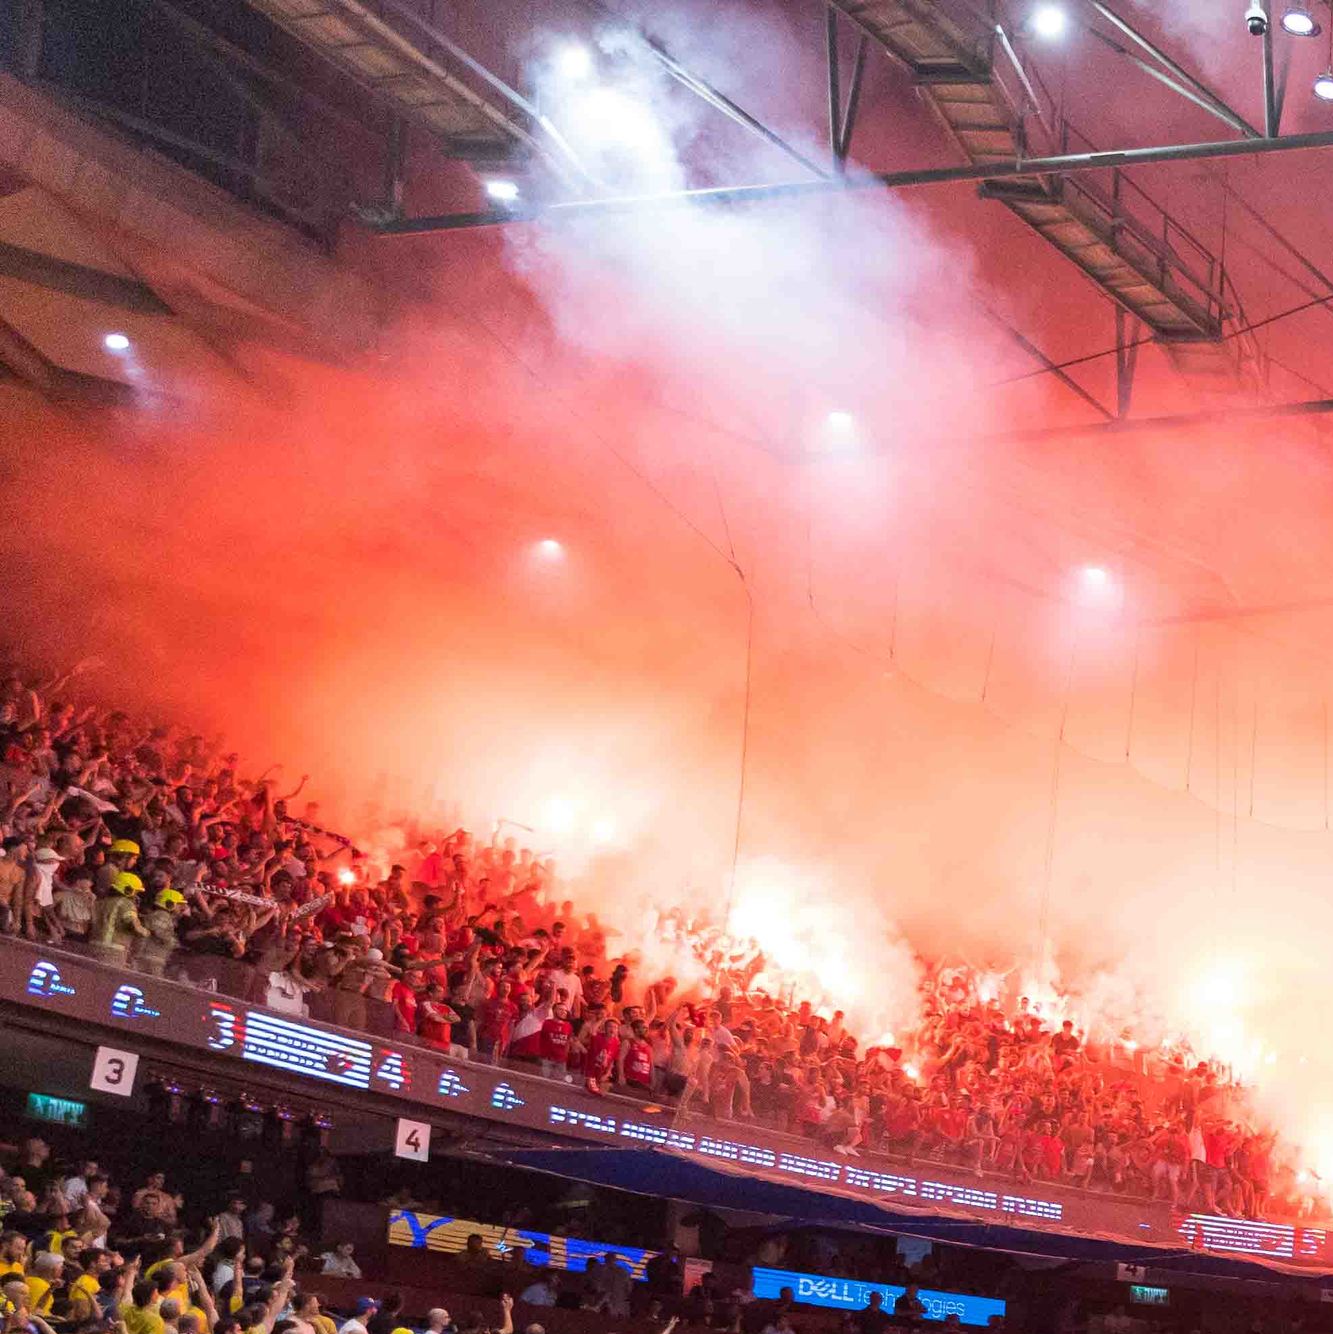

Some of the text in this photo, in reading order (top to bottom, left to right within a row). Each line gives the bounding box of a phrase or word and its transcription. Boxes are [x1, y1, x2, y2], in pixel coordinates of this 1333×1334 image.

[105, 1058, 125, 1085] 3
[404, 1128, 420, 1153] 4
[798, 1278, 854, 1302] DELL
